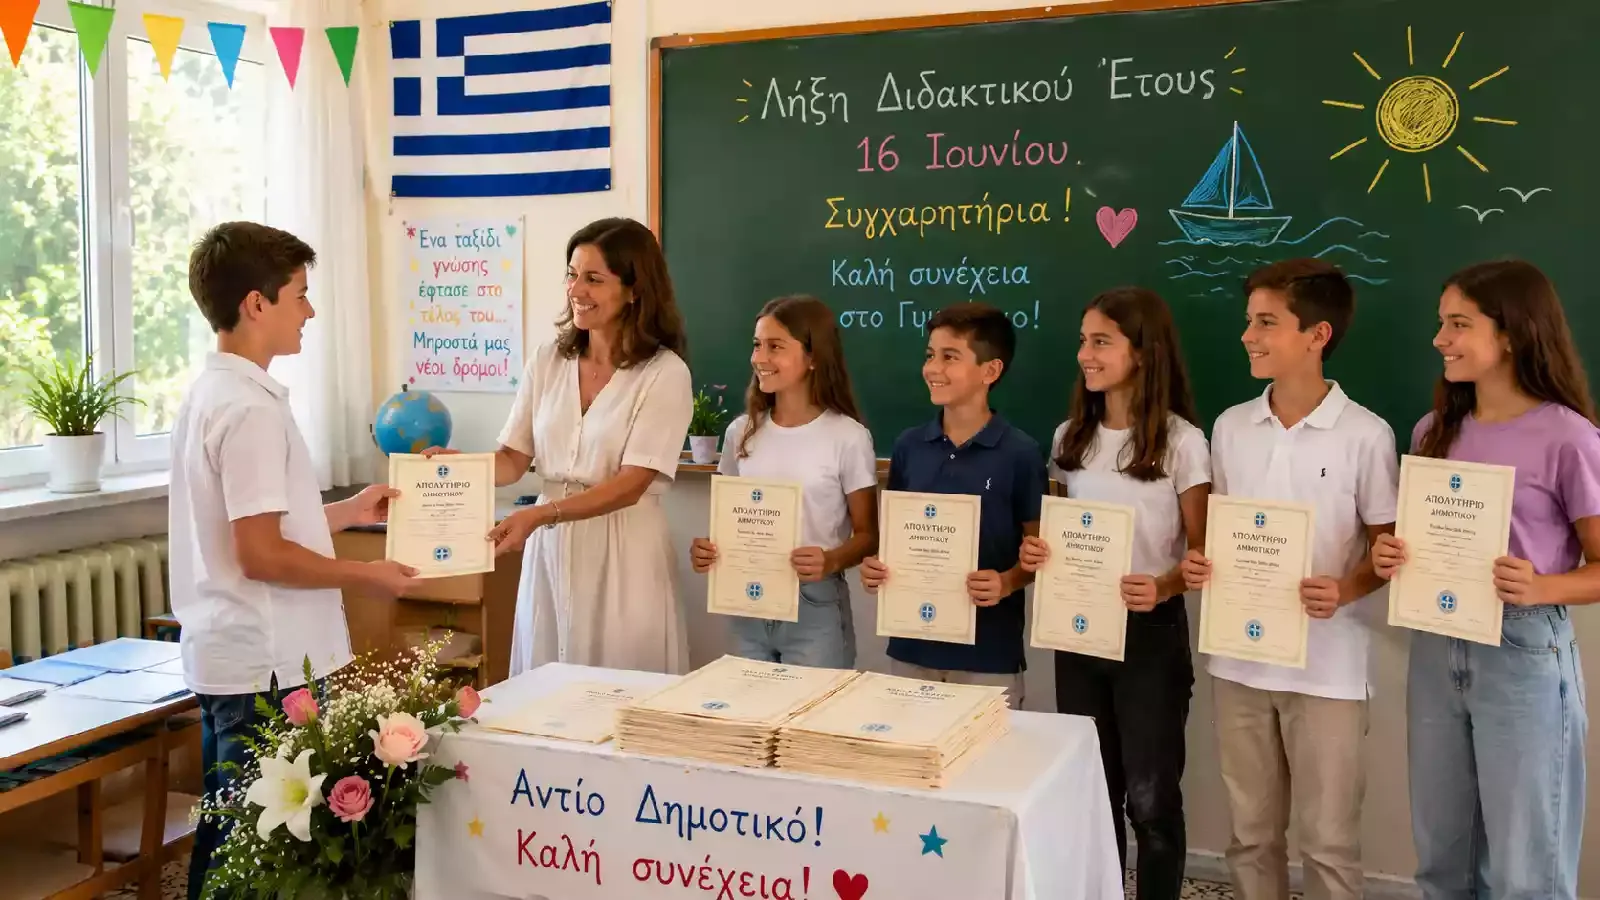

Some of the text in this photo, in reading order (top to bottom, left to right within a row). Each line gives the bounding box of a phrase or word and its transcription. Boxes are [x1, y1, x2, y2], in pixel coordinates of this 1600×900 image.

[760, 76, 849, 126] Λήξη
[876, 65, 1073, 113] Διδακτικού
[857, 129, 1068, 173] 16 Ιουνίου
[824, 191, 1051, 240] Συγχαρητήρια
[455, 228, 503, 252] ταξίδι
[433, 256, 489, 279] γνώσης
[831, 256, 1031, 295] Καλή συνέχεια
[418, 281, 503, 302] έφτασε στο
[420, 305, 461, 327] τέλος
[839, 310, 884, 329] στο
[485, 337, 511, 356] μας
[416, 357, 509, 383] νέοι δρόμοι!
[510, 767, 824, 847] Αντίο Δημοτικό!
[516, 828, 811, 900] Καλή συνέχεια!
